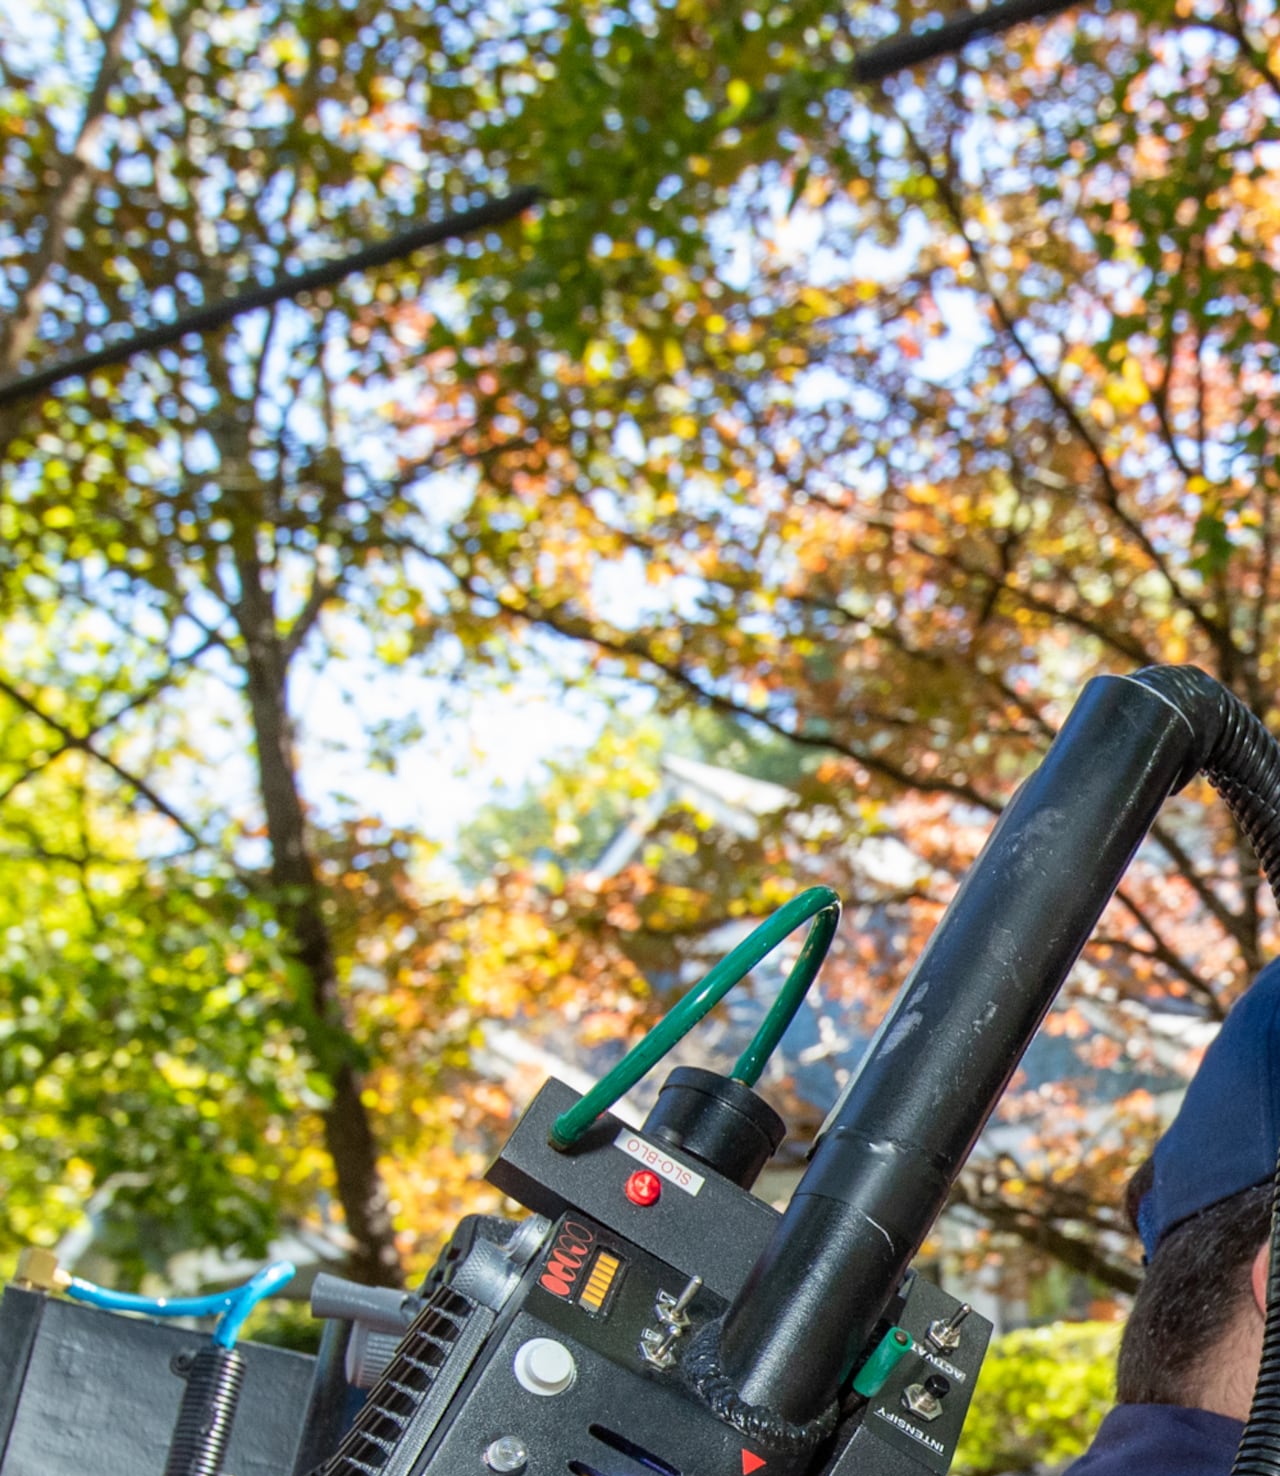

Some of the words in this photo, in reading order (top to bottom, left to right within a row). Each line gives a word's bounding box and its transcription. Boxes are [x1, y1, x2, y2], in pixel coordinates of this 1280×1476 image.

[626, 1138, 692, 1187] SLO-BLO
[908, 1340, 963, 1380] ACTIVAT
[876, 1405, 945, 1453] INTENSIFY
